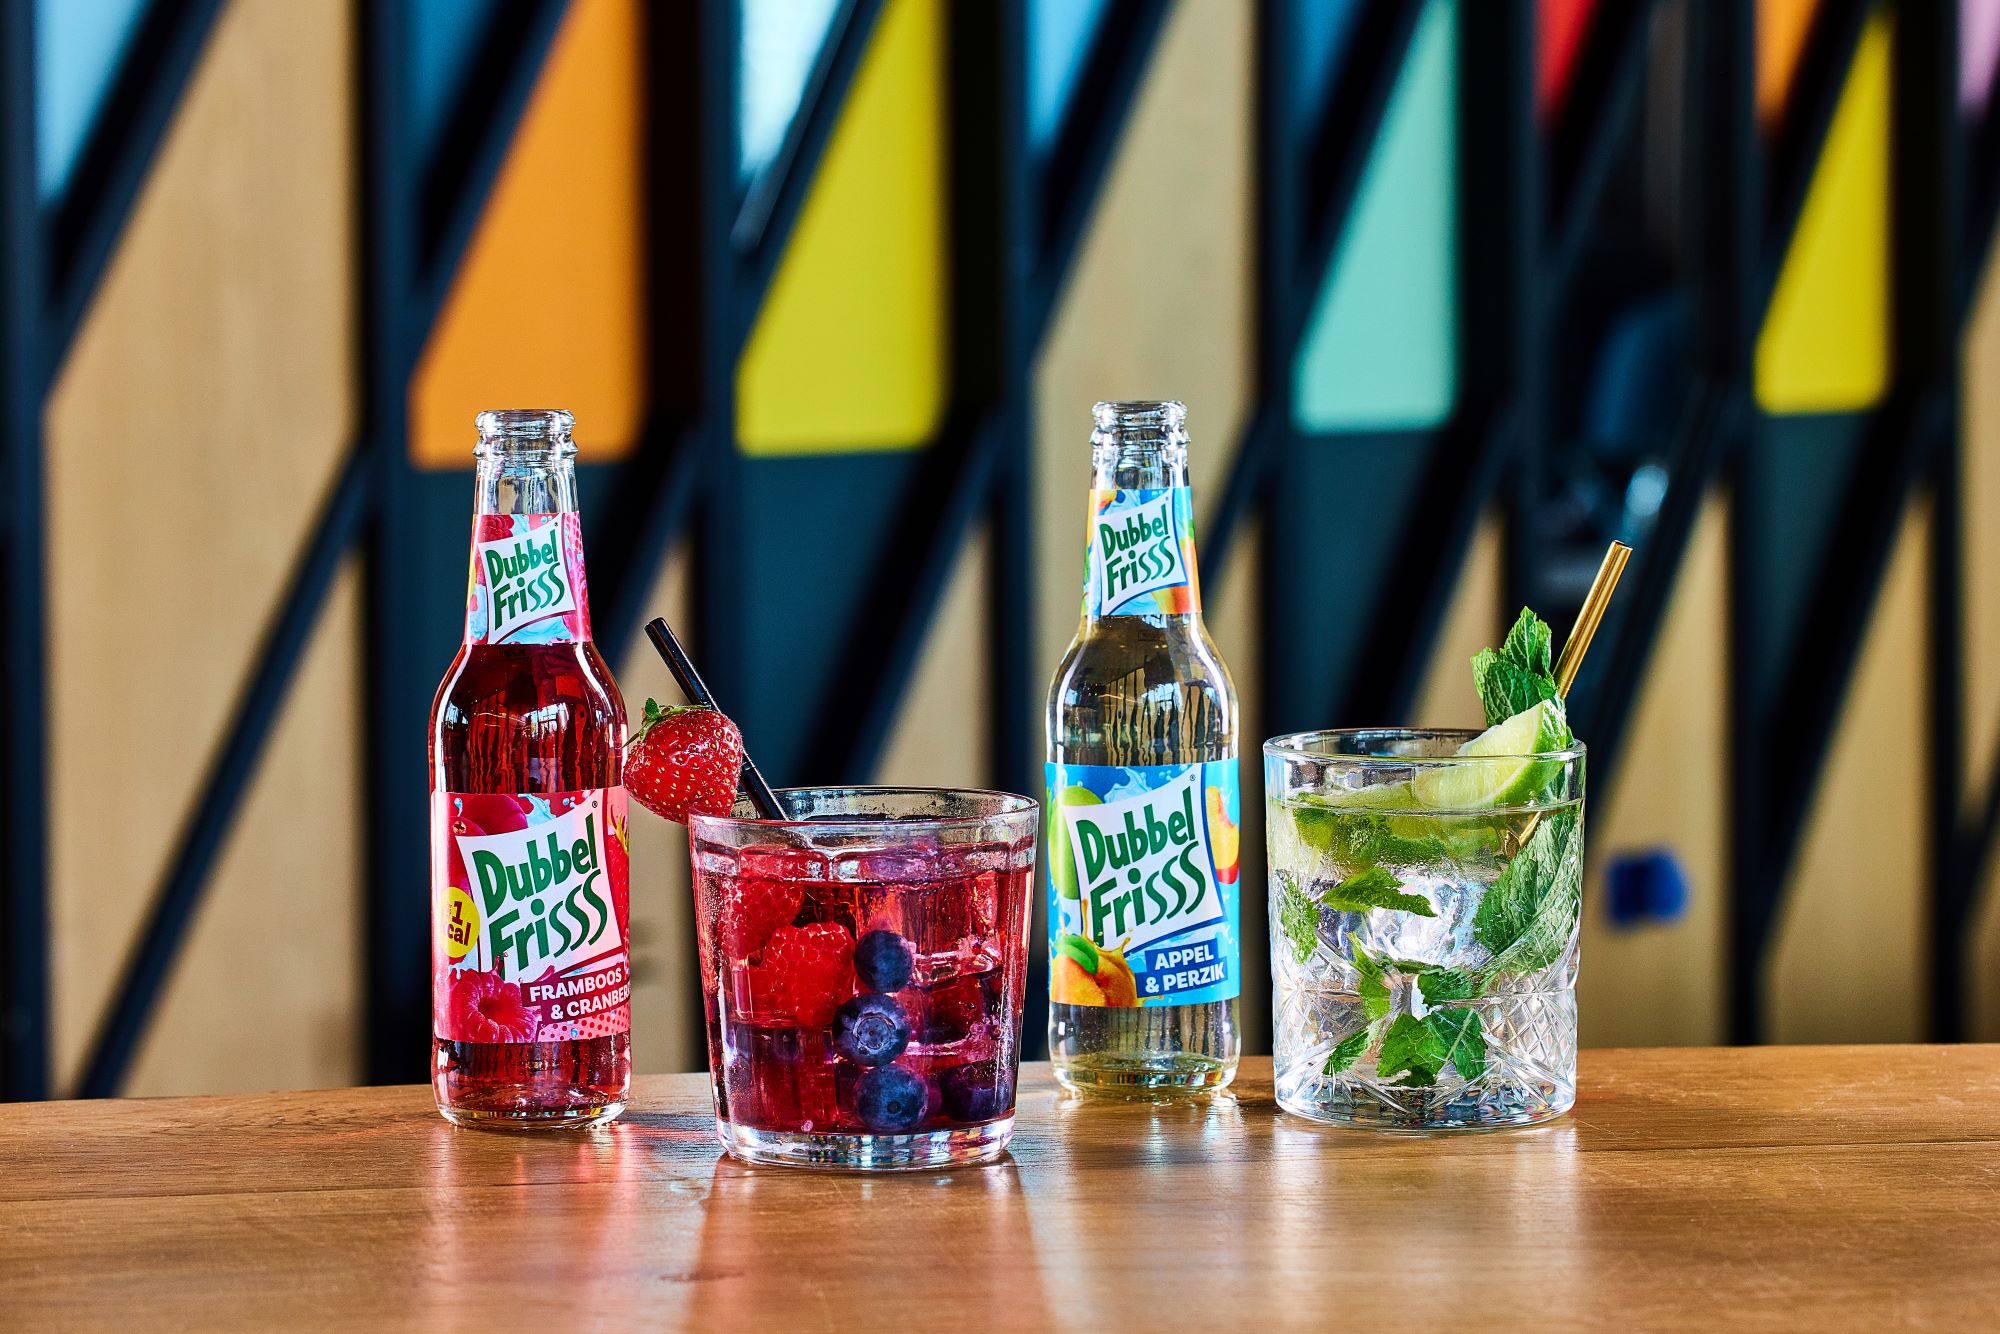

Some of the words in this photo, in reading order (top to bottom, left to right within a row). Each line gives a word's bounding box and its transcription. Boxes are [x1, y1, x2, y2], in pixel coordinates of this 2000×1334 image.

[1098, 503, 1169, 561] Dubbel
[485, 529, 559, 589] Dubbel
[1075, 786, 1196, 885] Dubbel
[471, 812, 598, 918] Dubbel
[1145, 976, 1160, 993] &
[1163, 962, 1225, 991] PERZIK
[1154, 944, 1214, 970] APPEL
[529, 967, 622, 1003] FRAMBOOS
[550, 1004, 564, 1020] &
